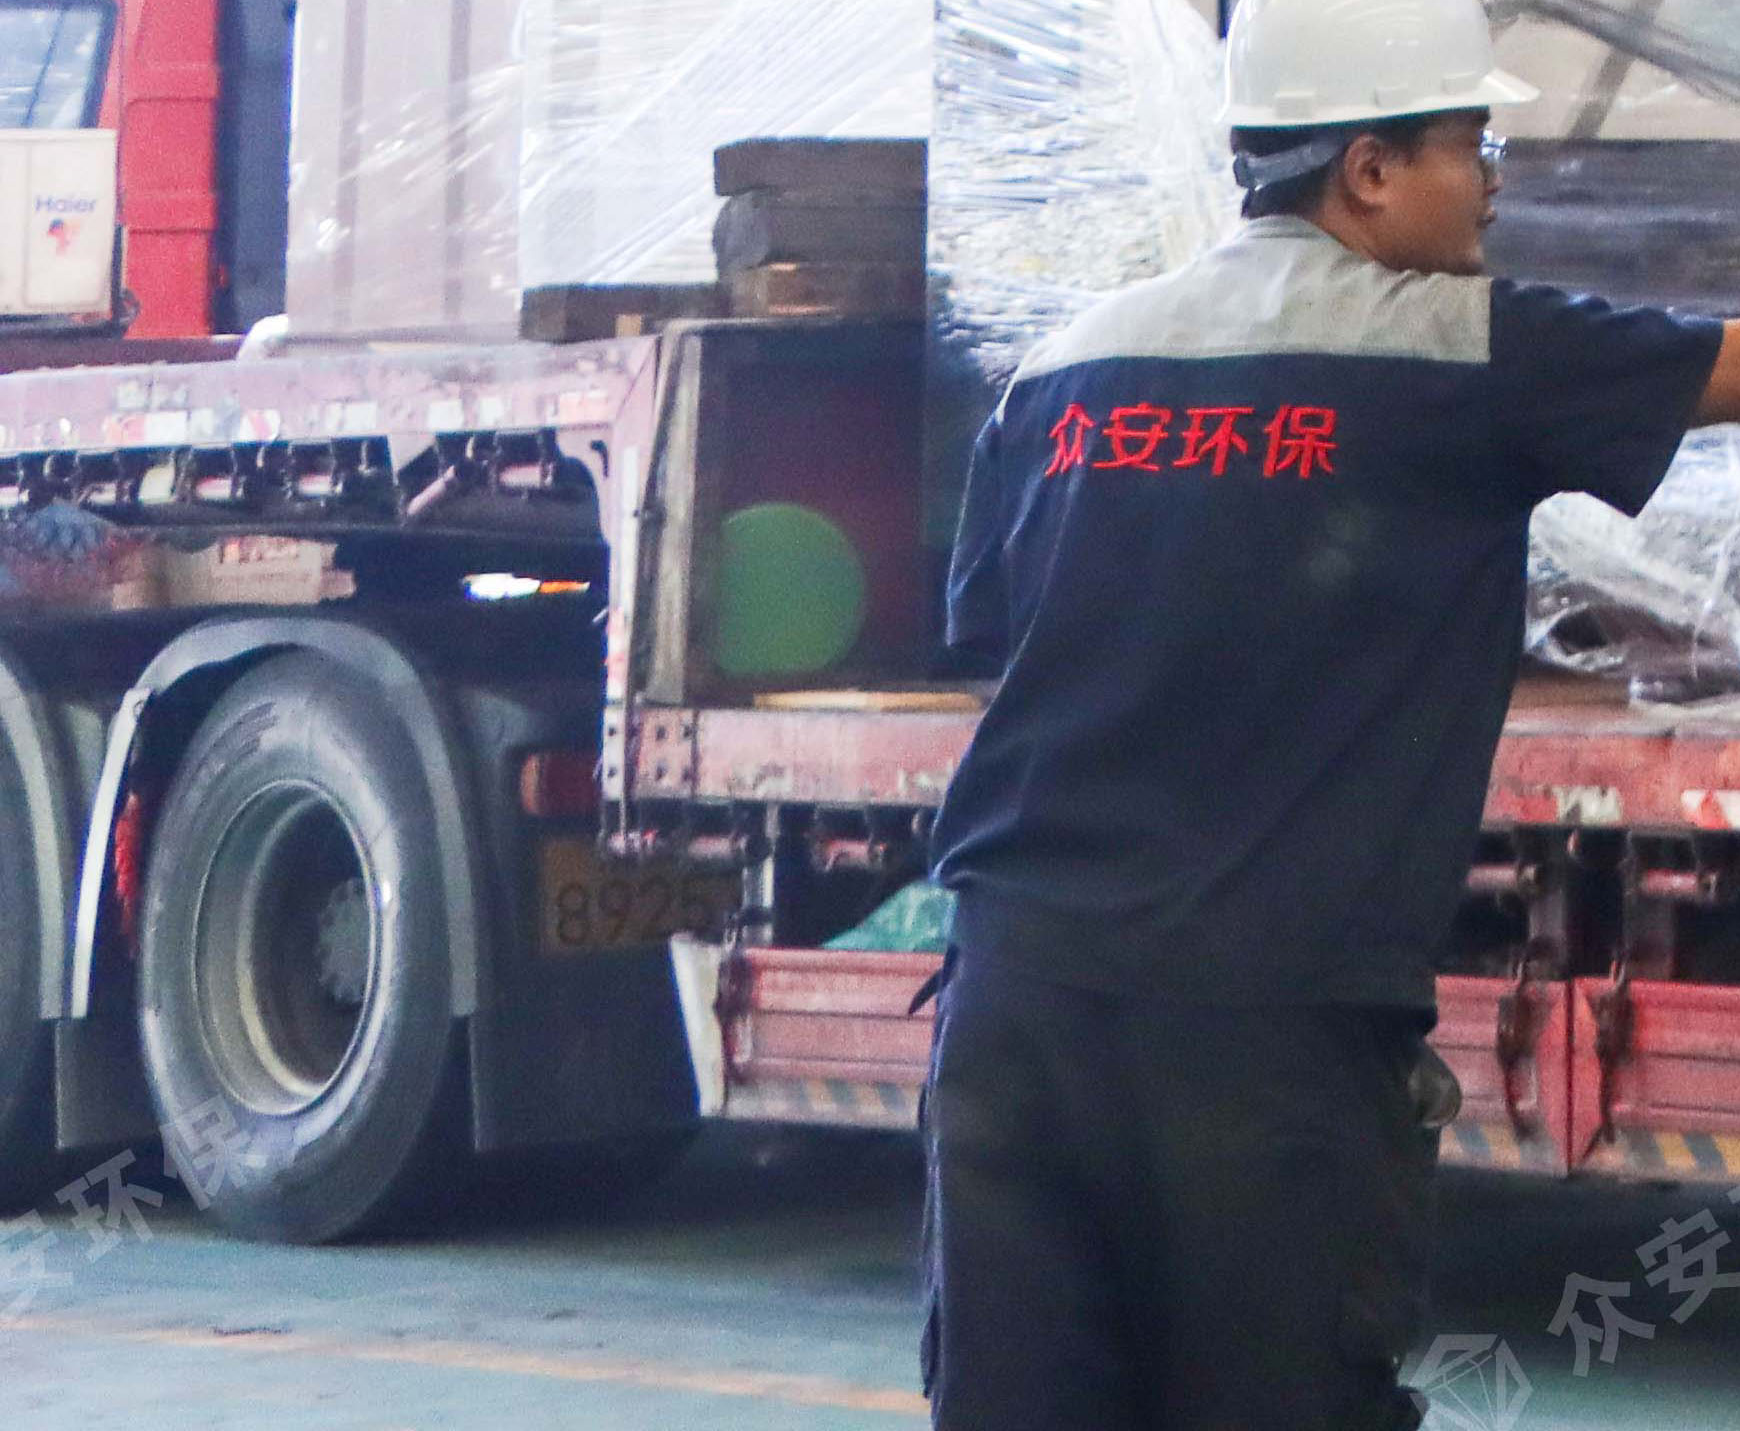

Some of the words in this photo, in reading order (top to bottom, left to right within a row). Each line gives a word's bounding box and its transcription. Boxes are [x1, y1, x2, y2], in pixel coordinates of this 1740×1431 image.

[35, 194, 96, 214] Haier
[1045, 402, 1337, 478] 众安环保
